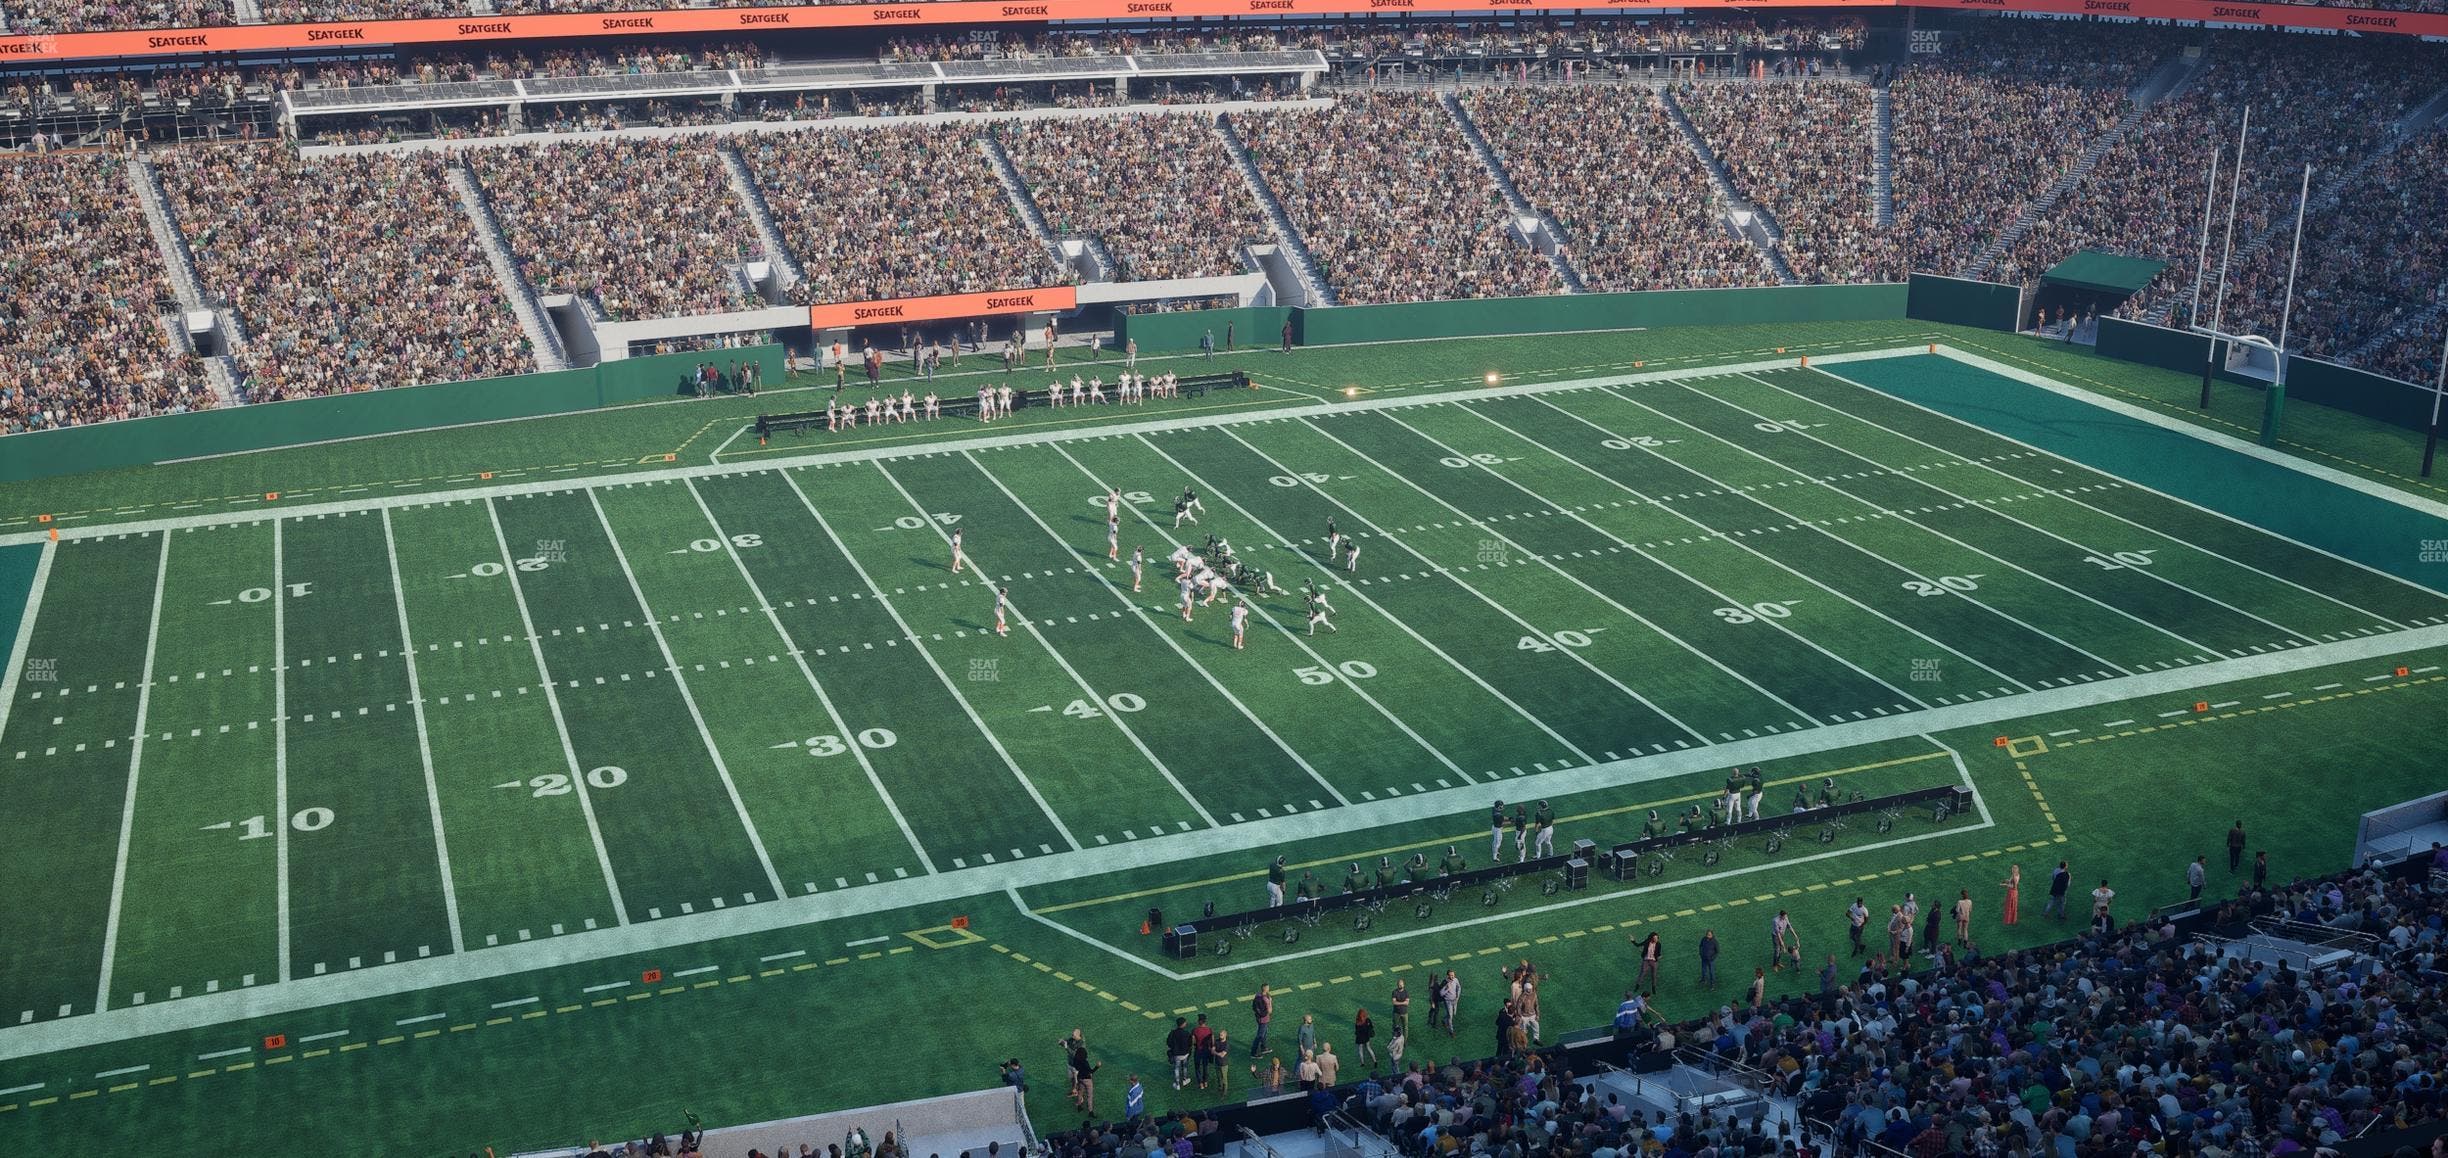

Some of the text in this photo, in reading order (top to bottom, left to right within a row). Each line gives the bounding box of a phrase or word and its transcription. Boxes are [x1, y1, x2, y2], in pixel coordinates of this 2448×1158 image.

[1002, 6, 1048, 16] SEATGEEK
[1128, 3, 1172, 13] SEATGEEK
[1250, 0, 1294, 10] SEATGEEK
[1371, 0, 1414, 8] SEATGEEK
[2084, 0, 2130, 11] SEATGEEK
[740, 13, 789, 24] SEATGEEK
[873, 9, 921, 20] SEATGEEK
[2213, 6, 2260, 19] SEATGEEK
[458, 23, 511, 35] SEATGEEK
[602, 17, 653, 29] SEATGEEK
[2346, 15, 2397, 28] SEATGEEK
[148, 34, 208, 49] SEATGEEK
[308, 28, 365, 41] SEATGEEK
[987, 295, 1034, 309] SEATGEEK
[854, 305, 904, 320] SEATGEEK
[895, 512, 962, 529] 40
[690, 534, 763, 552] 30
[471, 557, 549, 577] 20
[2083, 551, 2152, 571] 10
[238, 581, 312, 603] 10
[1901, 576, 1978, 597] 20
[1712, 602, 1791, 624] 30
[1517, 630, 1592, 653] 40
[1292, 660, 1378, 686] 50
[1062, 692, 1147, 719] 40
[805, 727, 898, 757] 30
[529, 766, 628, 798] 20
[238, 807, 335, 841] 10
